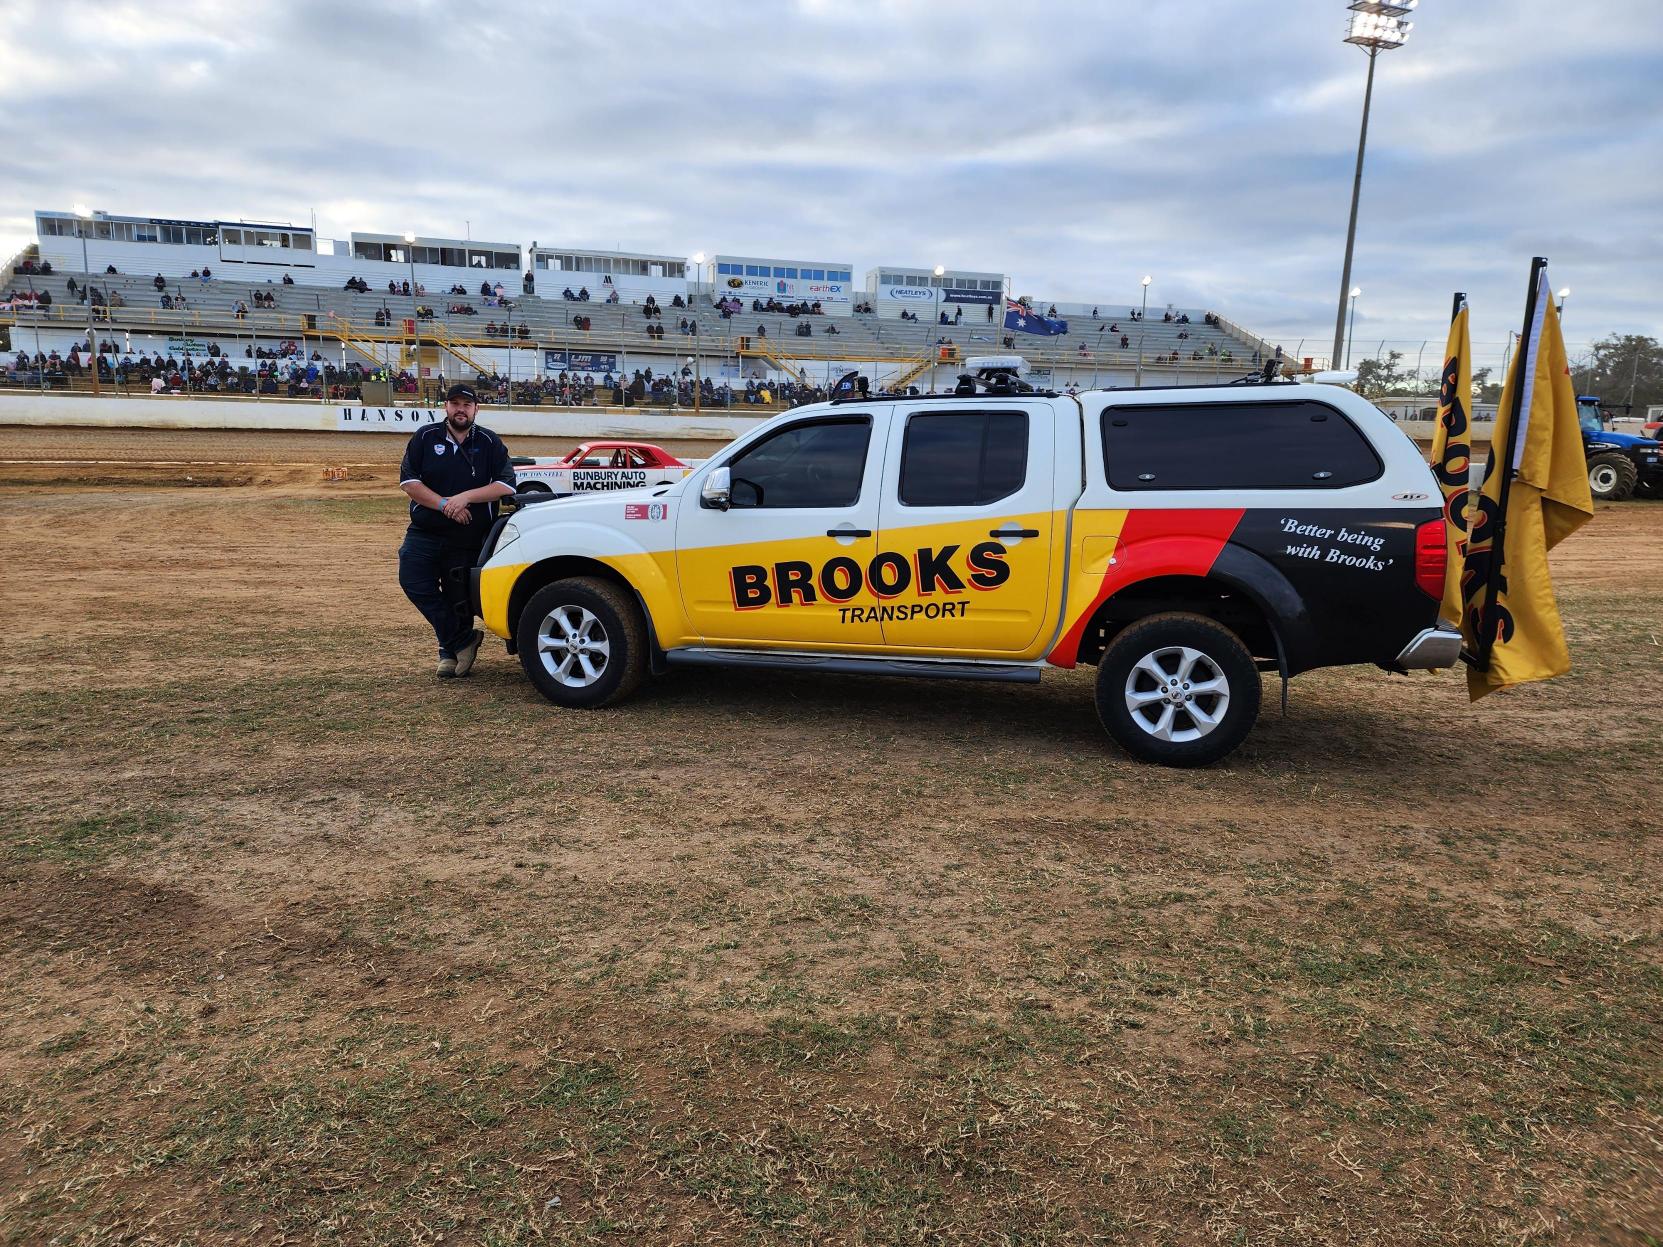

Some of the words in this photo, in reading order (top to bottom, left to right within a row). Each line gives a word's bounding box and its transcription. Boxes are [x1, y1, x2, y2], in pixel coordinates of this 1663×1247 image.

[343, 408, 436, 423] HANSON
[572, 471, 618, 481] BUNBURY
[620, 471, 646, 480] AUTO
[573, 481, 647, 490] MACHINING
[1336, 528, 1386, 552] being
[1286, 543, 1322, 560] with
[728, 541, 1011, 612] BROOKS
[838, 601, 970, 624] TRANSPORT
